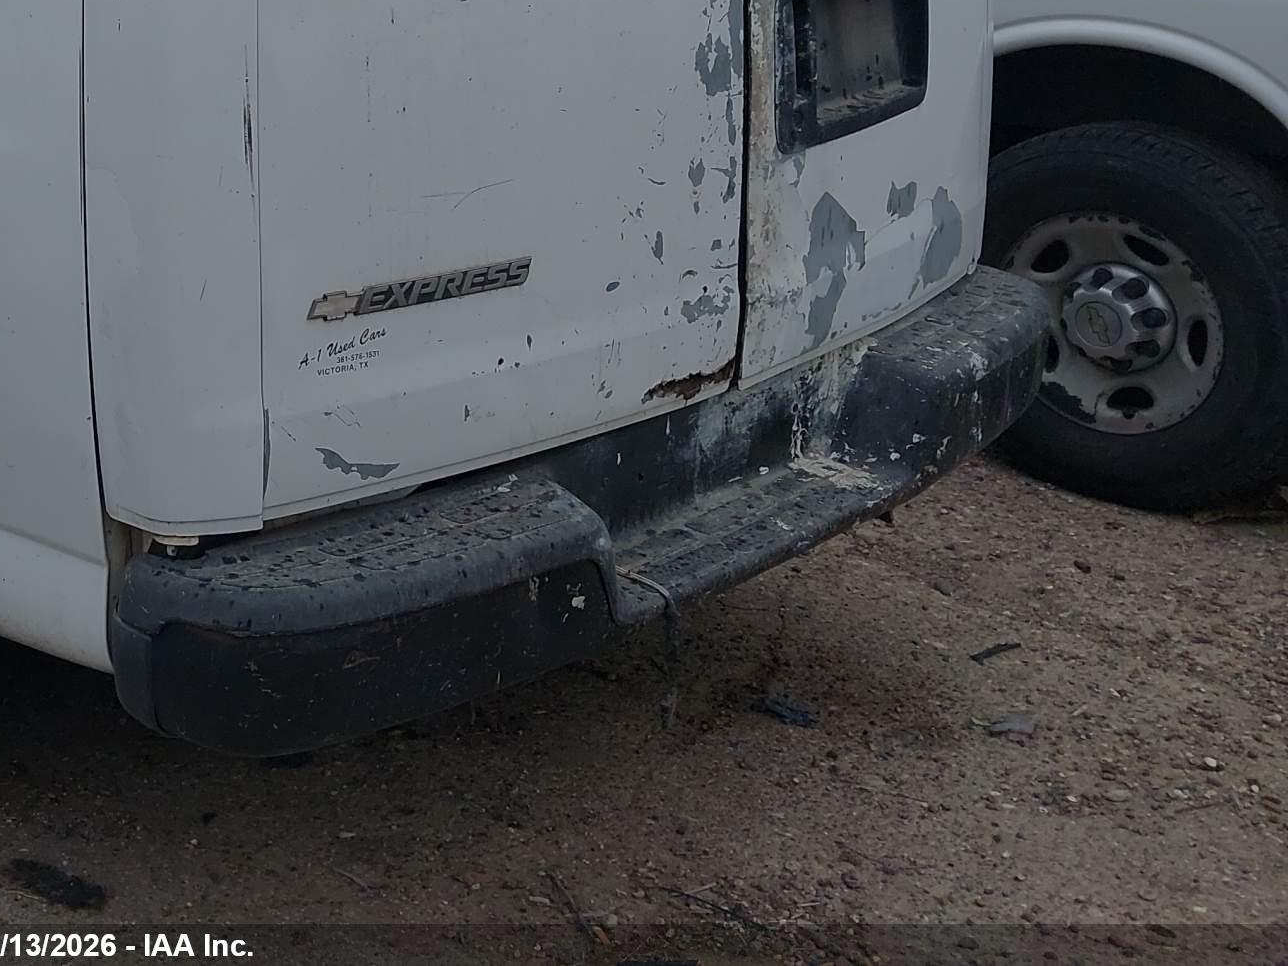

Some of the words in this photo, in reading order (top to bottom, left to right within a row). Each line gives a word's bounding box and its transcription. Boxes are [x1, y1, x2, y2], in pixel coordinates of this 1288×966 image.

[359, 259, 531, 314] EXPRESS
[298, 352, 322, 370] A-1
[326, 337, 355, 357] Used
[359, 328, 386, 345] Cars
[317, 363, 357, 376] VICTORIA,
[359, 361, 369, 369] TX
